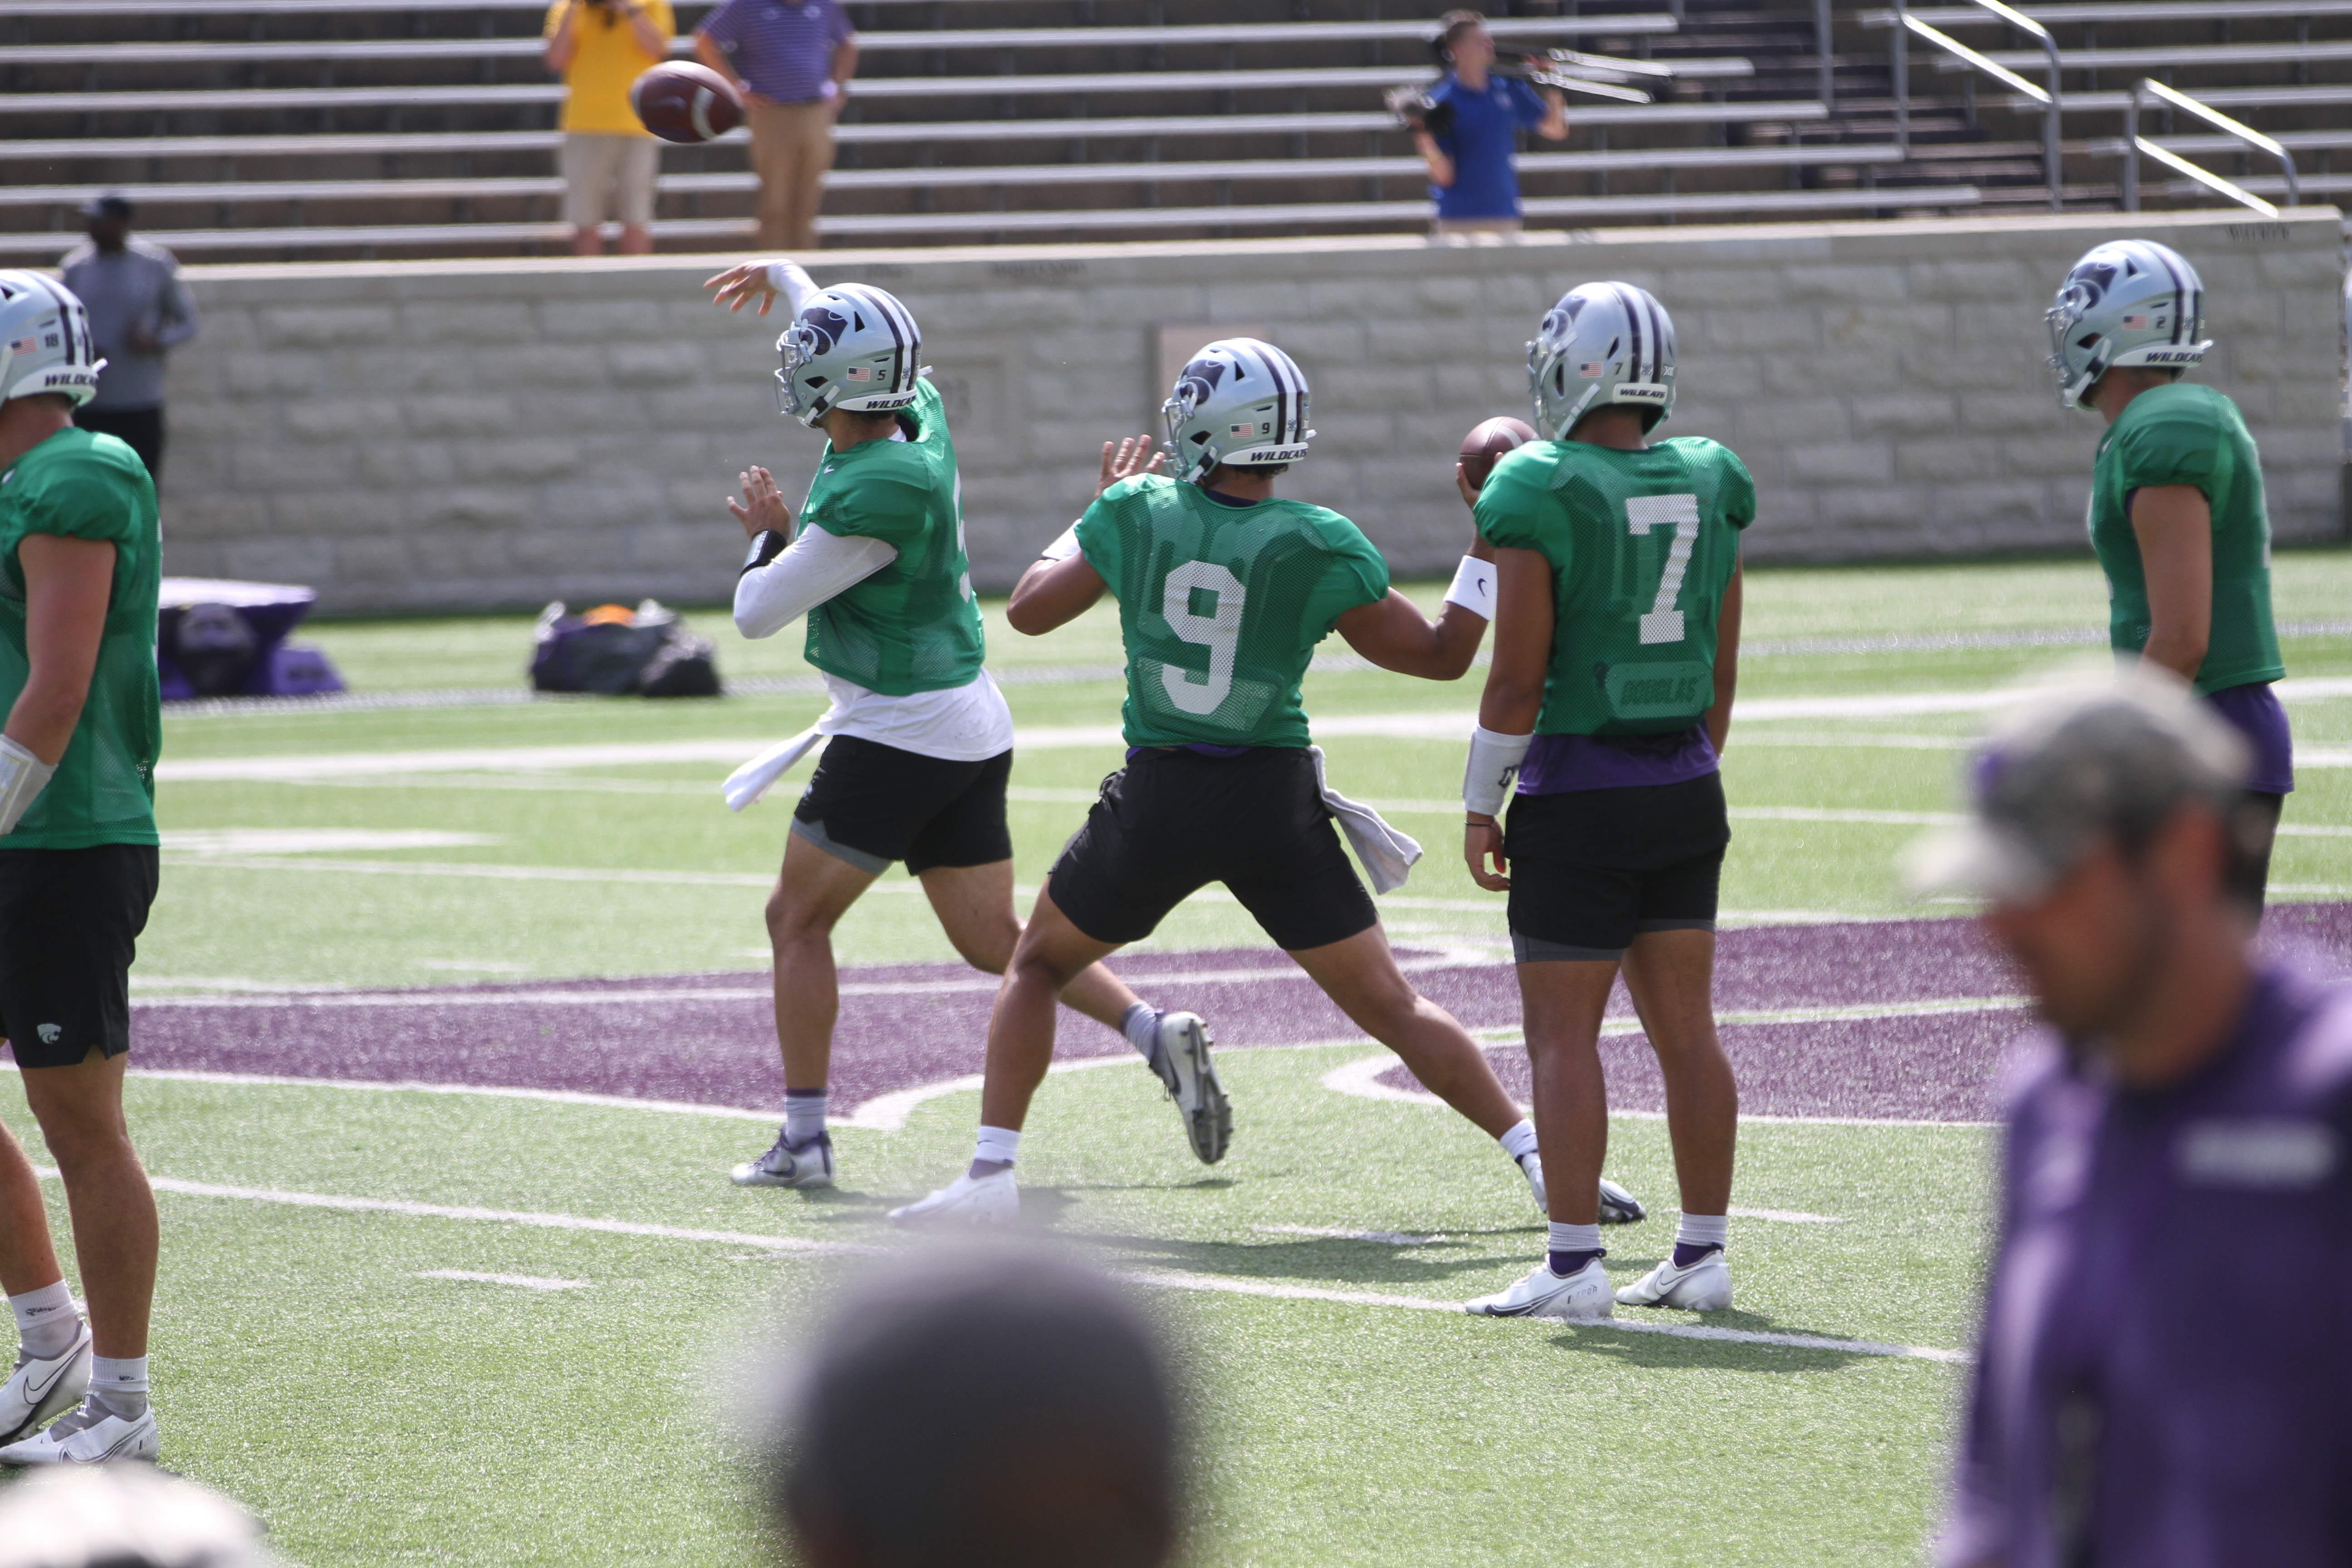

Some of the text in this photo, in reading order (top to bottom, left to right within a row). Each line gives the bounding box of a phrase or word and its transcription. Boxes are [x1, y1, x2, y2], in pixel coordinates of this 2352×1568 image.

[2156, 316, 2166, 329] 2
[45, 333, 59, 348] 18
[877, 369, 887, 380] 5
[1615, 362, 1623, 375] 7
[1620, 389, 1666, 398] WILDCATS
[1262, 422, 1270, 434] 9
[1251, 448, 1308, 461] WILDCATS
[1626, 493, 1700, 645] 7
[1161, 559, 1246, 715] 9
